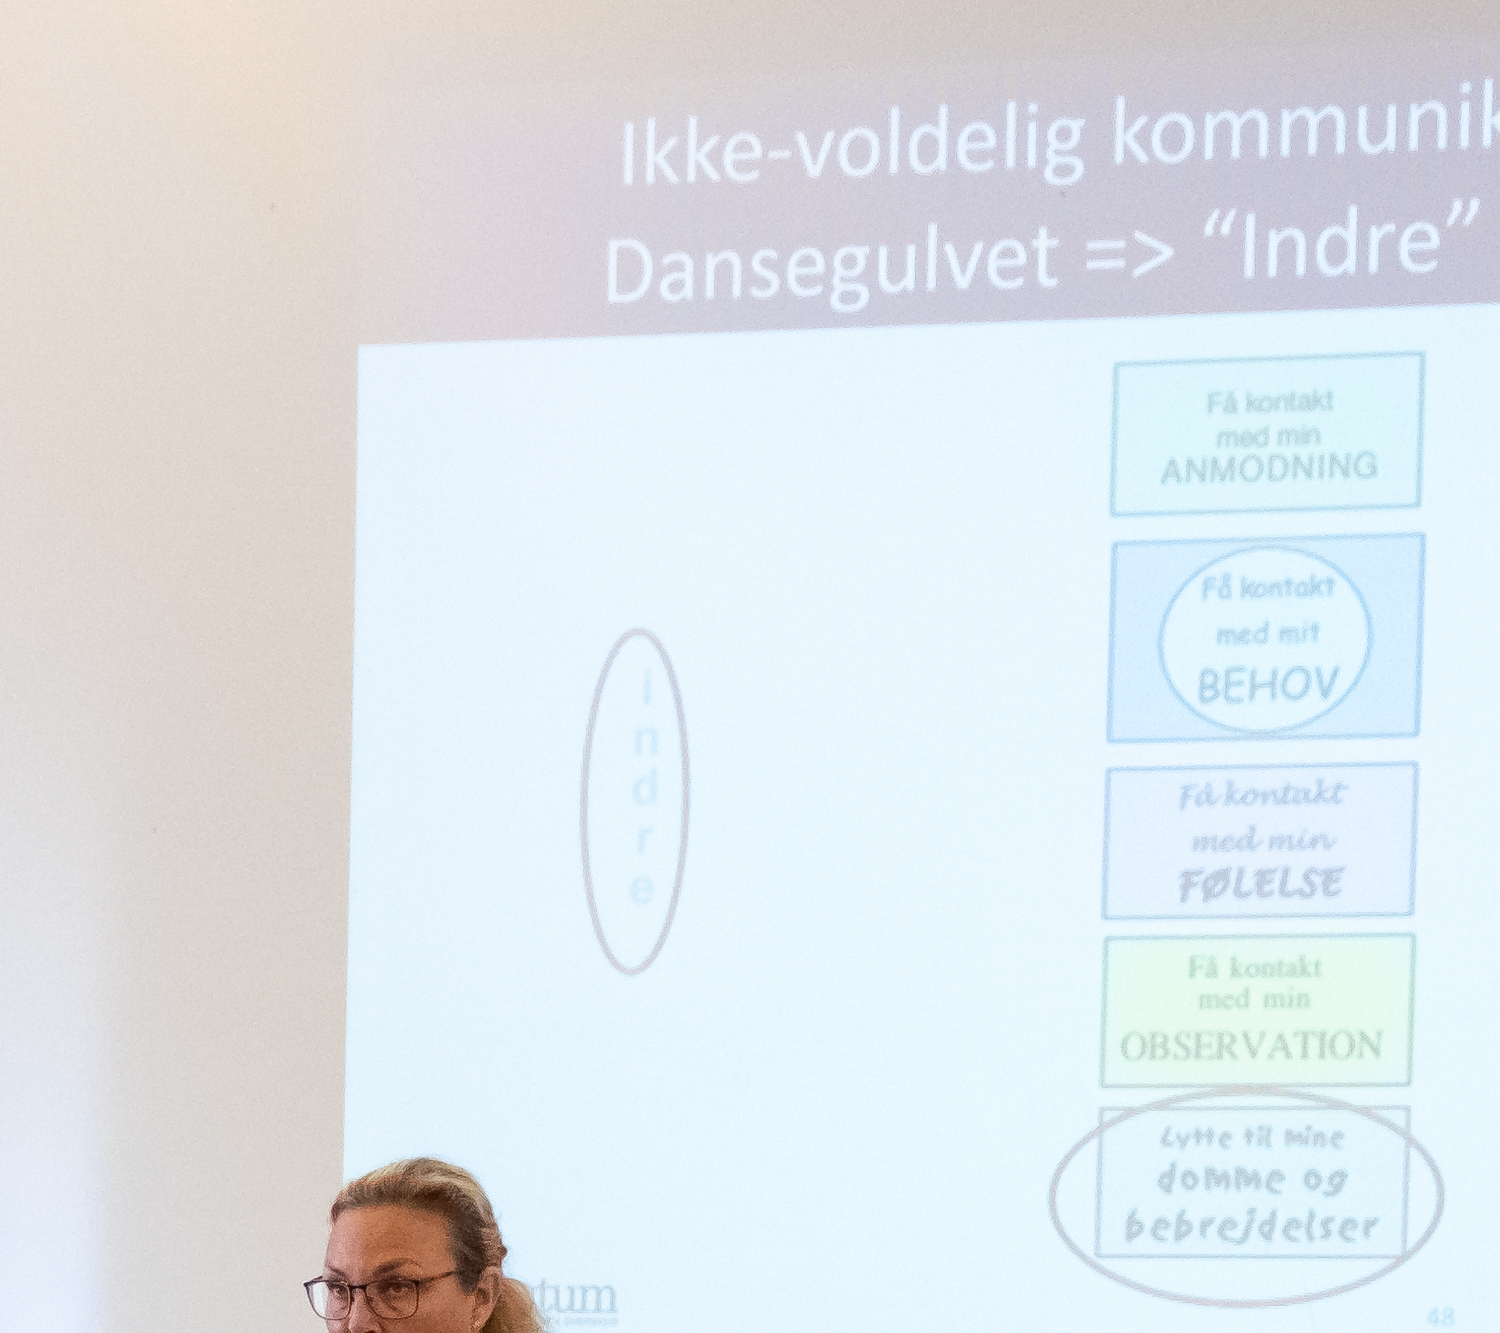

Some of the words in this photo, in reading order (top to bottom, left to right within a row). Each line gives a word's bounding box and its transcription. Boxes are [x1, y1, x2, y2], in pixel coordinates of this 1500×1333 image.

[622, 99, 1086, 186] Ikke-voldelig
[607, 221, 1060, 314] Dansegulvet
[1208, 391, 1237, 413] Få
[1246, 390, 1333, 412] kontakt
[1217, 426, 1269, 448] med
[1278, 426, 1320, 447] min
[1161, 451, 1378, 484] ANMODNING
[1202, 573, 1232, 599] Få
[1241, 575, 1335, 598] kontakt
[1217, 620, 1269, 644] med
[1279, 620, 1320, 643] mit
[1199, 666, 1340, 704] BEHOV
[1180, 782, 1220, 810] Få
[1223, 778, 1349, 807] kontakt
[1192, 824, 1263, 852] med
[1268, 828, 1336, 851] min
[1180, 865, 1346, 903] FØLELSE
[1189, 955, 1218, 978] Få
[1230, 955, 1322, 978] kontakt
[1199, 987, 1249, 1010] med
[1264, 987, 1310, 1008] min
[1121, 1029, 1384, 1061] OBSERVATION
[1161, 1125, 1232, 1149] Lytte
[1245, 1125, 1271, 1148] til
[1157, 1162, 1285, 1195] domme
[1303, 1168, 1348, 1197] og
[1125, 1207, 1379, 1246] bebrejdelser
